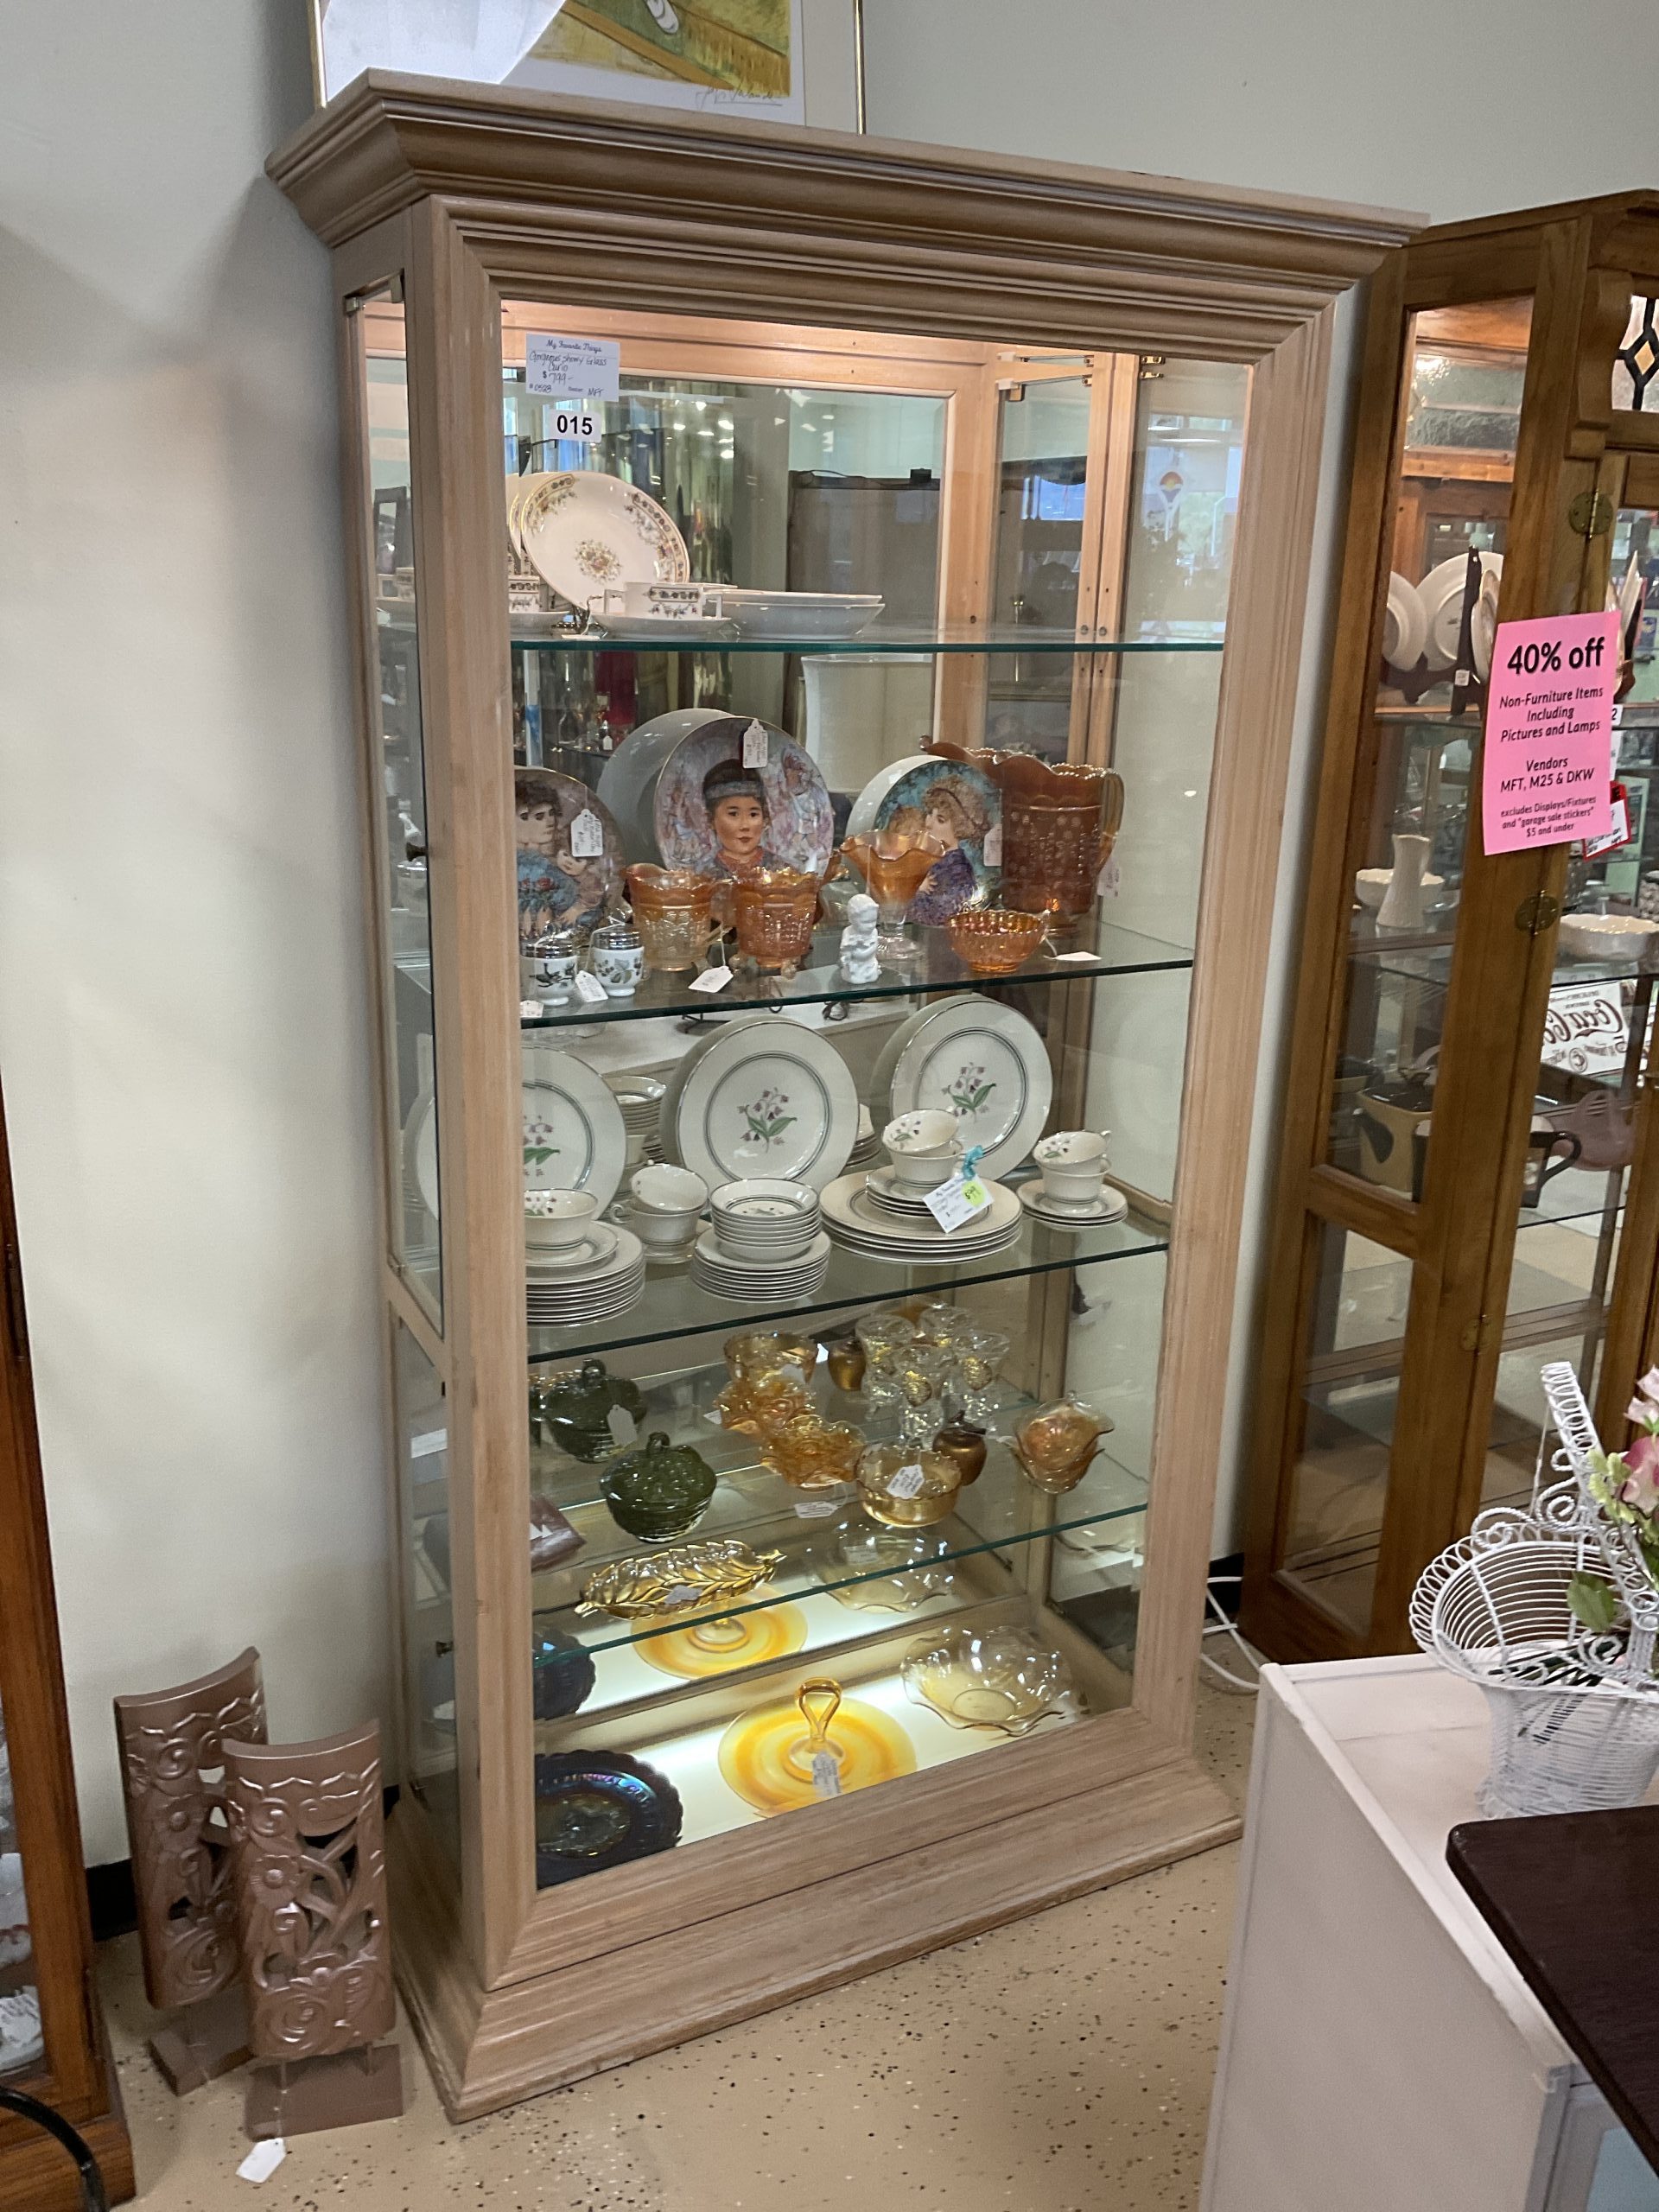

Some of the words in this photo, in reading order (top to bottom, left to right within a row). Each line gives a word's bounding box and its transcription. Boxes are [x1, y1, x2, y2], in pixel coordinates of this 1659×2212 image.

[546, 340, 556, 349] My
[556, 415, 593, 435] 015
[1507, 641, 1562, 676] 40%
[1568, 636, 1605, 670] off
[1499, 690, 1573, 709] Non-Furniture
[1575, 685, 1604, 700] Items
[1527, 706, 1574, 722] Including
[1500, 724, 1543, 743] Pictures
[1547, 722, 1565, 736] and
[1567, 719, 1600, 734] Lamps
[1526, 756, 1568, 772] Vendors
[1500, 778, 1527, 793] MFT,
[1529, 772, 1554, 789] M25
[1556, 772, 1564, 785] &
[1567, 768, 1594, 784] DKW
[1501, 804, 1533, 818] excludes
[1534, 796, 1597, 814] Displays/Fixtures
[1502, 818, 1516, 830] and
[1548, 811, 1561, 823] sale
[1526, 827, 1536, 837] $5
[1538, 825, 1552, 836] and
[1554, 823, 1574, 833] under
